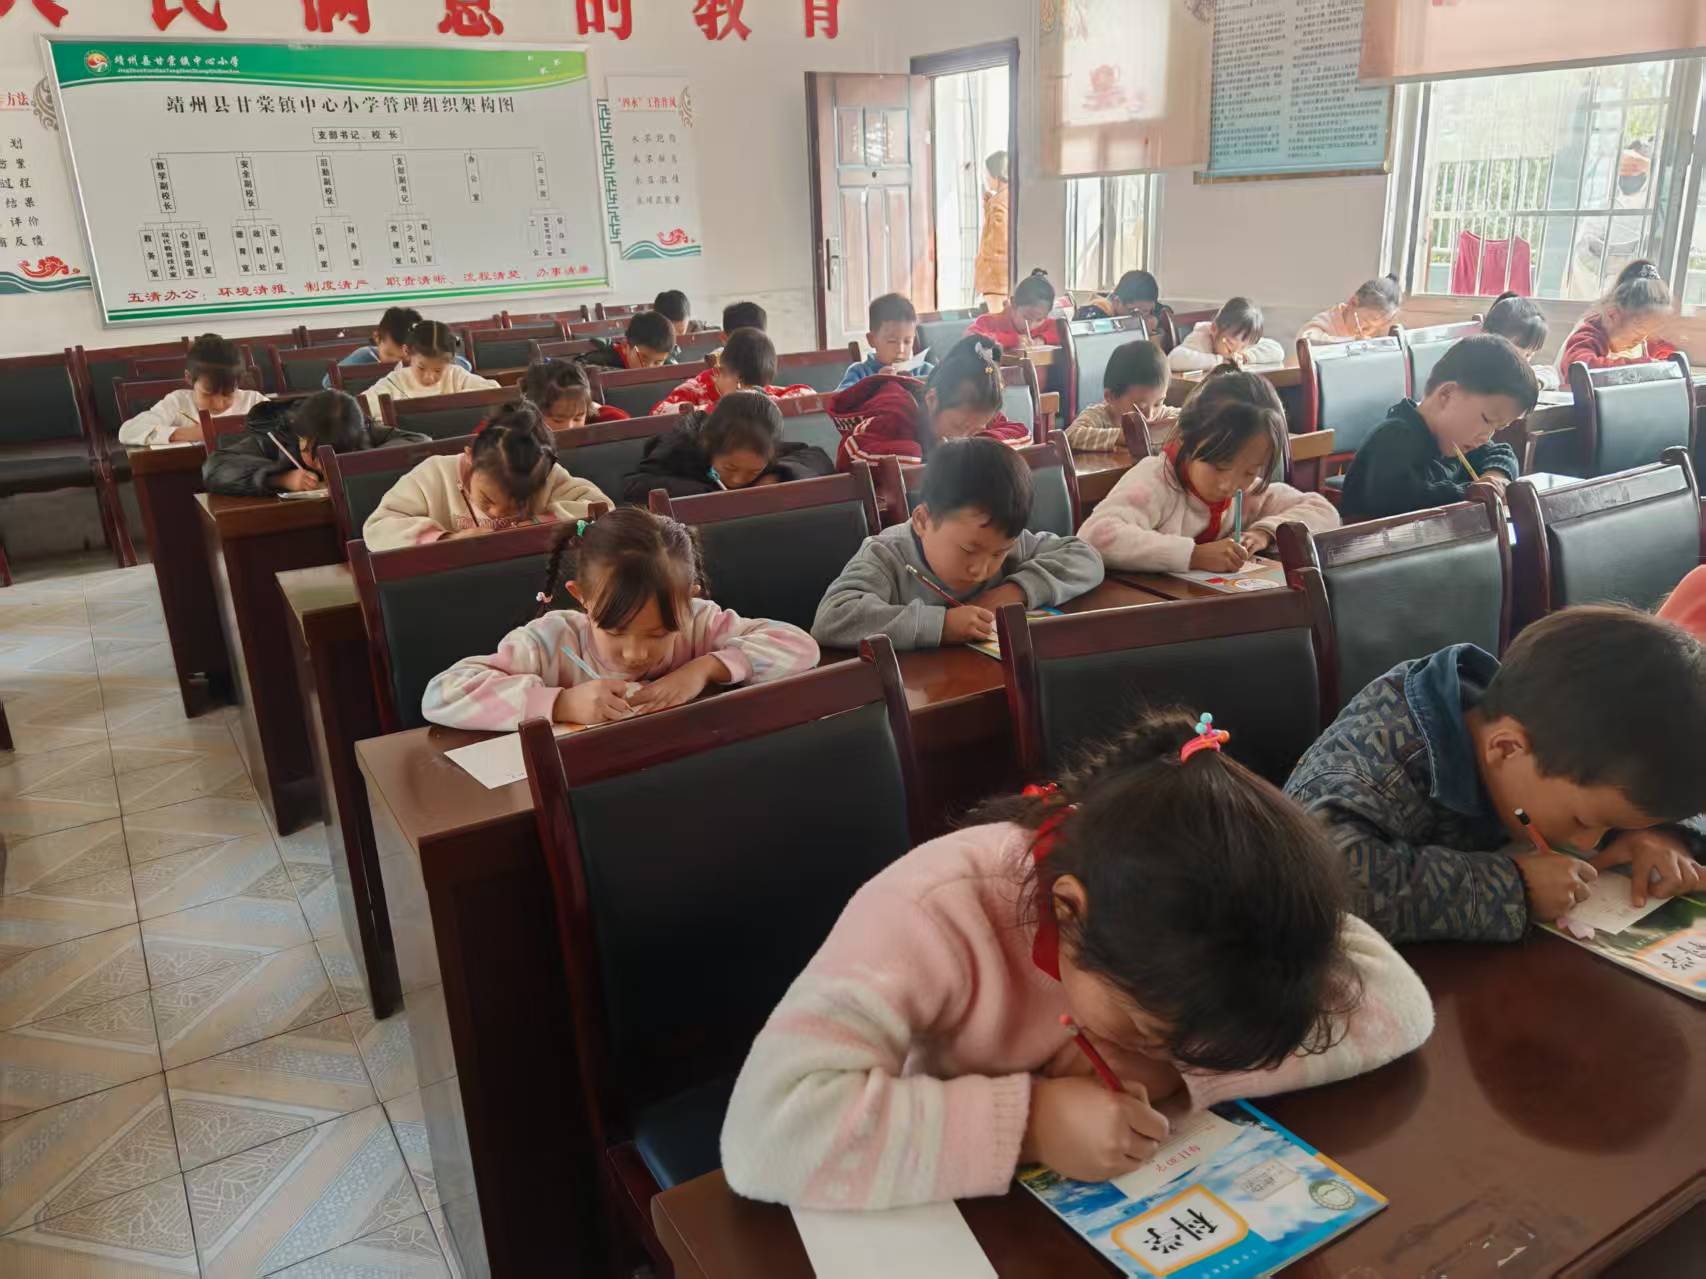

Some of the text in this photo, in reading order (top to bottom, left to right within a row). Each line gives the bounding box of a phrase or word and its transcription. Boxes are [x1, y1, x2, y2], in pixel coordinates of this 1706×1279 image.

[166, 96, 514, 113] 靖州县甘棠镇中心小学管理组织架构图
[1143, 1208, 1219, 1254] 科学
